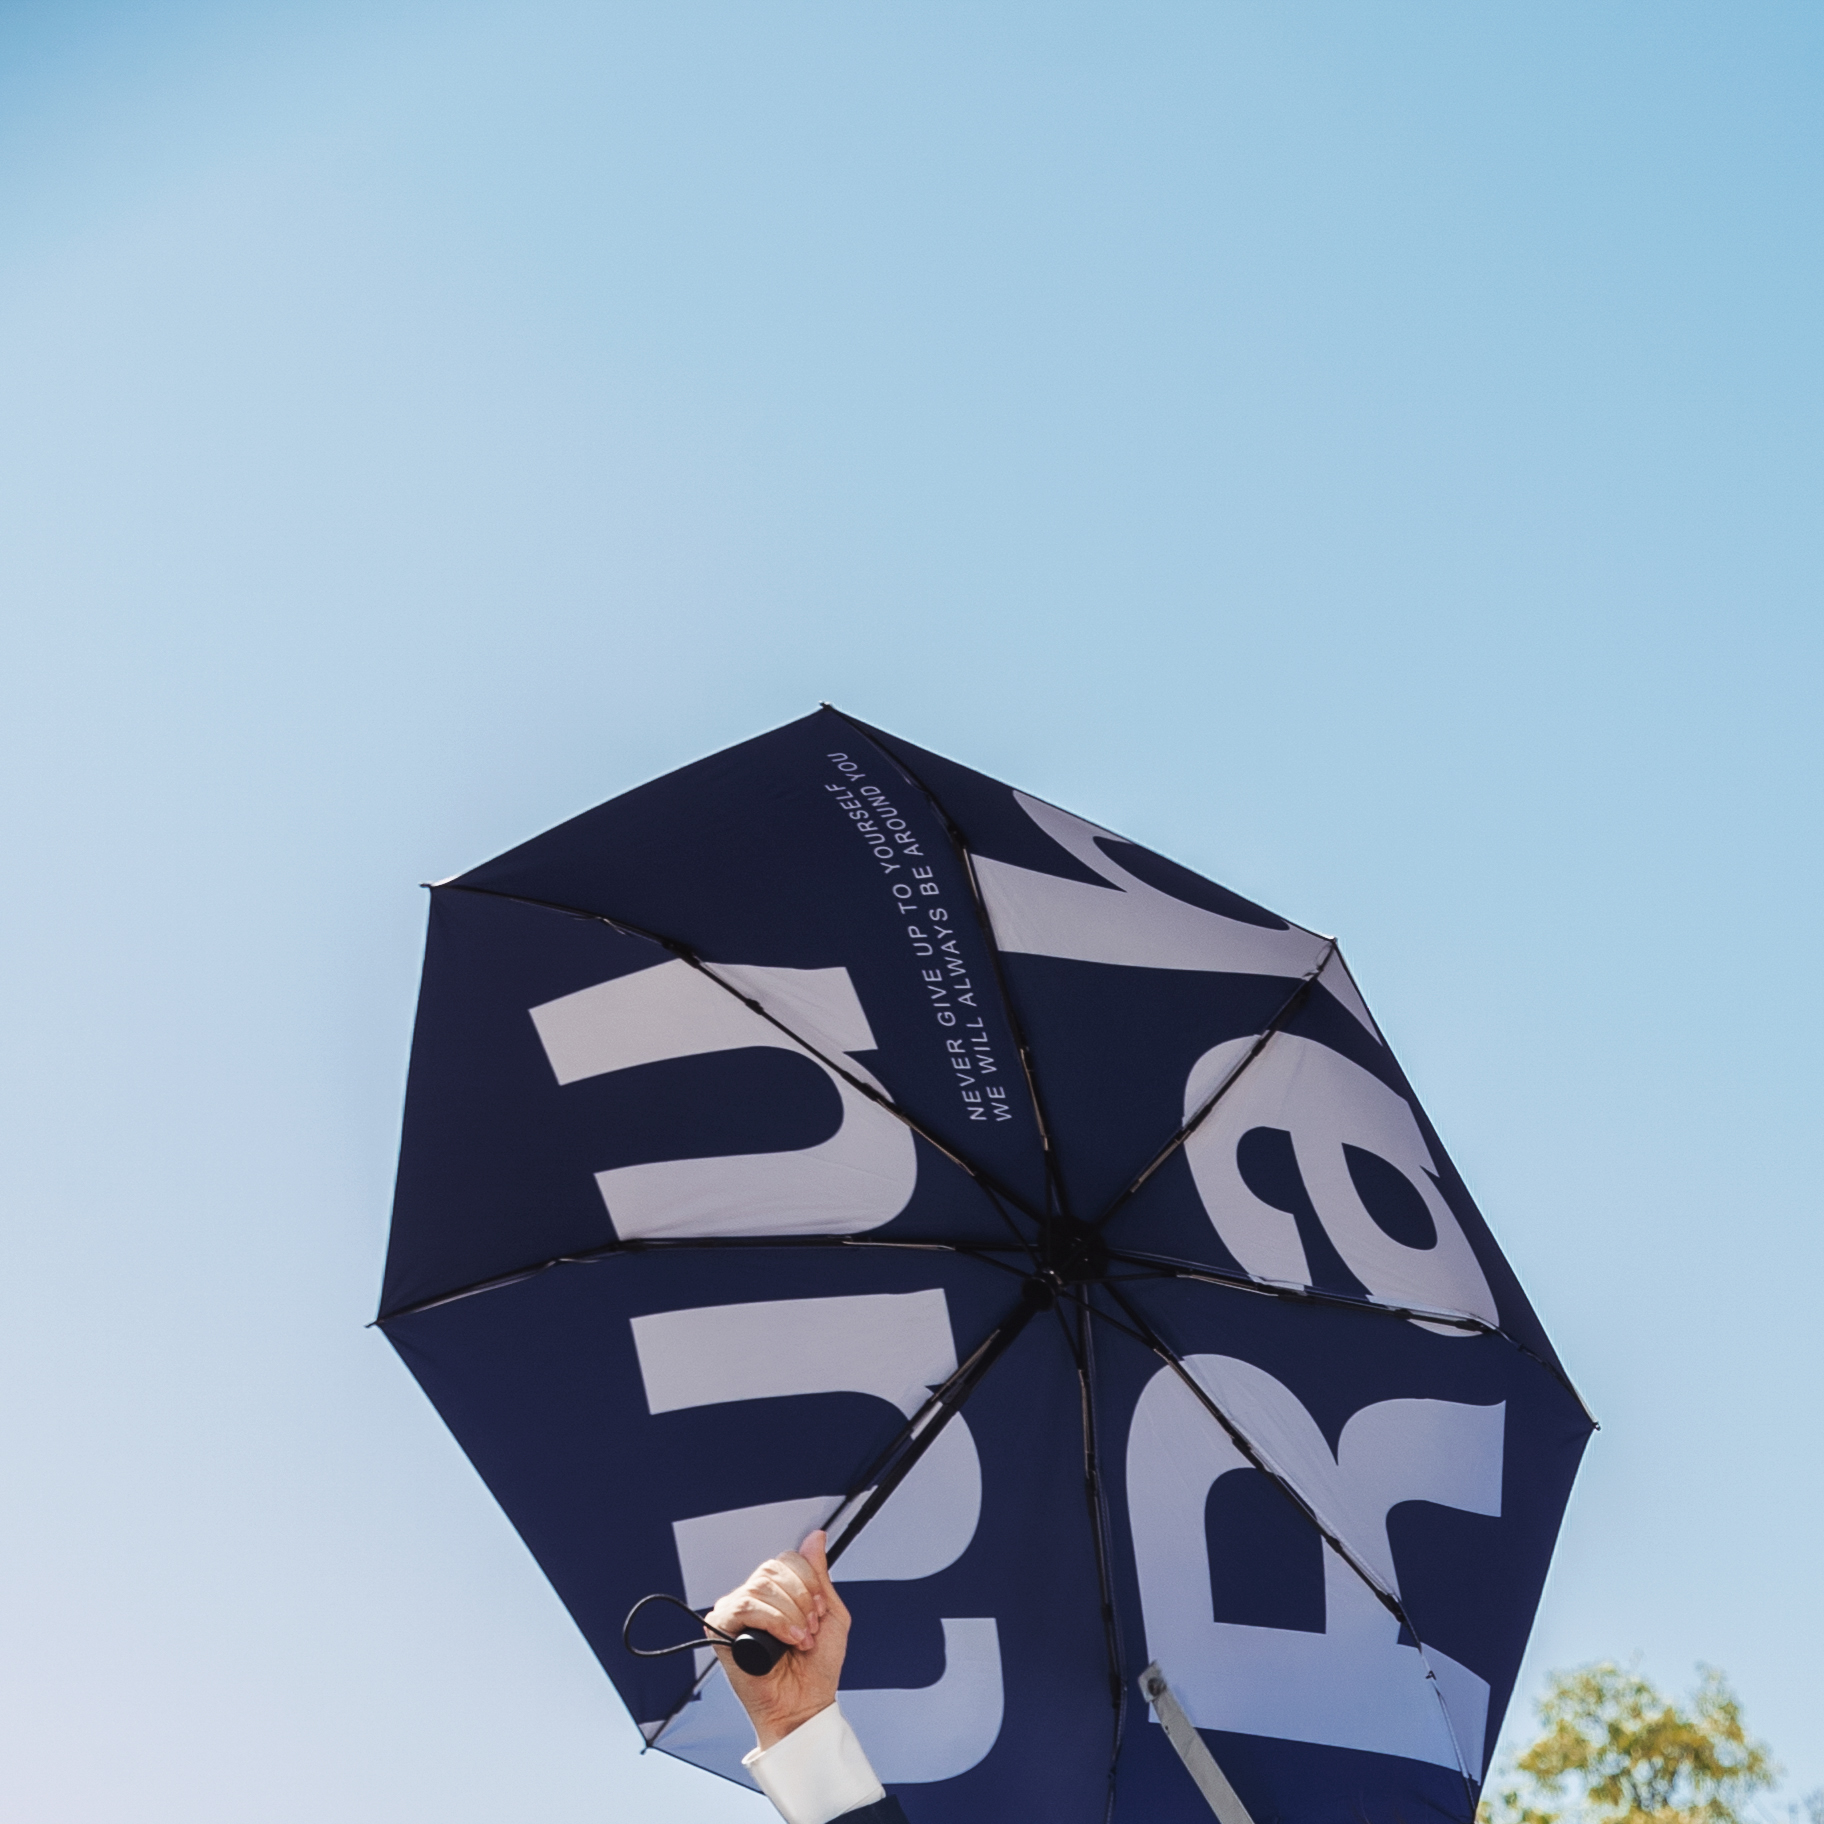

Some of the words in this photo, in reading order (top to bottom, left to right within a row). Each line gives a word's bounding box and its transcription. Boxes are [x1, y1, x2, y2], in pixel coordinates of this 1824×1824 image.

[827, 752, 866, 783] YOU
[825, 783, 900, 874] YOURSELF
[860, 785, 924, 857] AROUND
[892, 883, 917, 914] TO
[912, 865, 940, 896] BE
[908, 925, 934, 956] UP
[929, 907, 977, 1007] ALWAYS
[922, 968, 957, 1027] GIVE
[965, 1016, 997, 1074] WILL
[946, 1038, 987, 1121] NEVER
[986, 1086, 1012, 1122] WE
